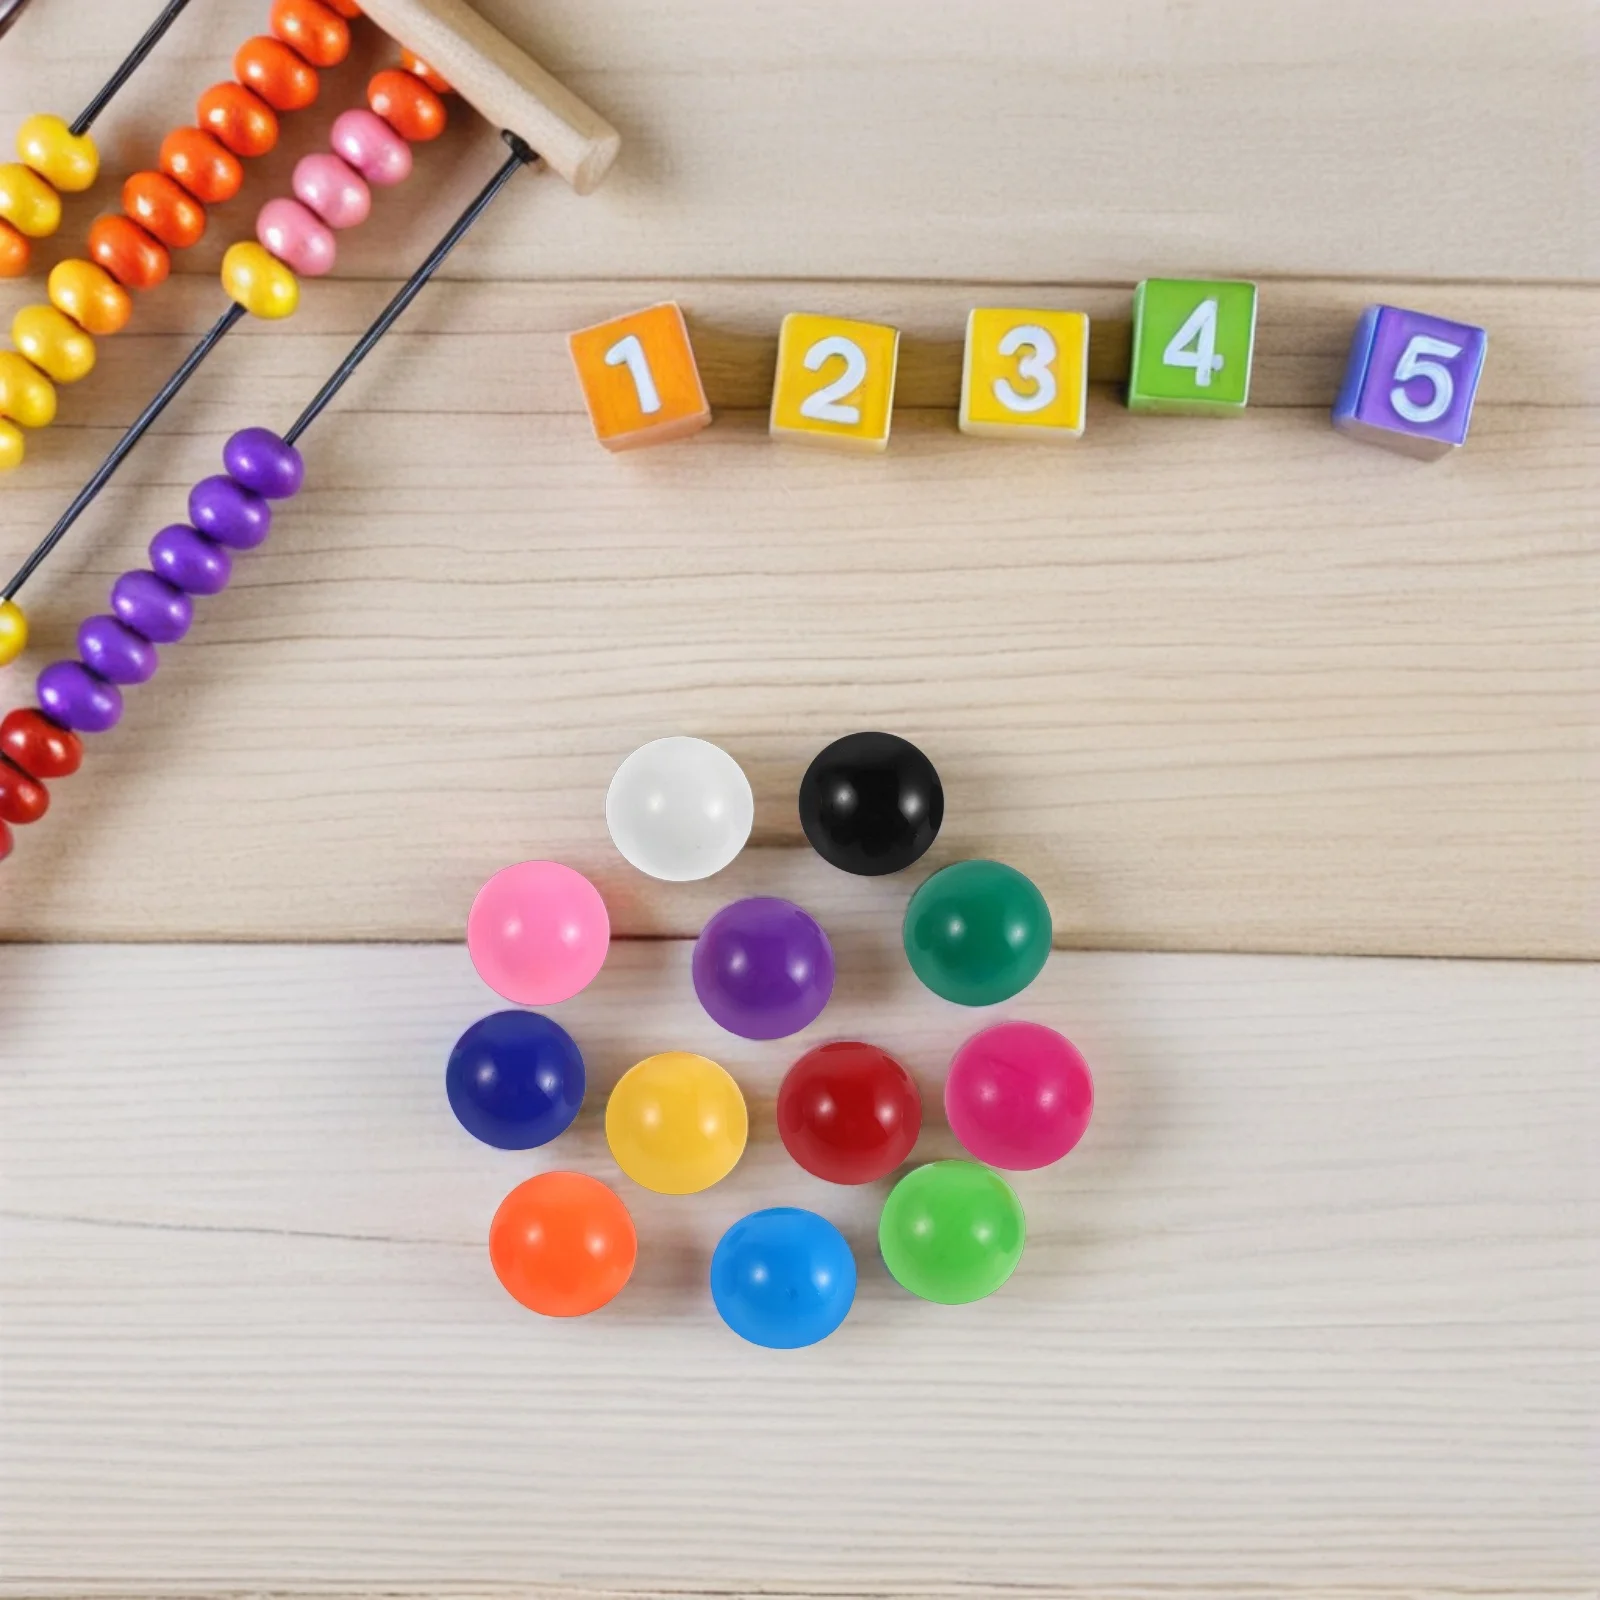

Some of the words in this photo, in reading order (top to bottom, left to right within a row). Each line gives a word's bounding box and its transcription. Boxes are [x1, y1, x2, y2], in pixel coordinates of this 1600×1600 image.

[604, 335, 661, 414] 1
[801, 335, 867, 424] 2
[993, 324, 1057, 412] 3
[1162, 298, 1224, 386] 4
[1390, 335, 1463, 423] 5
